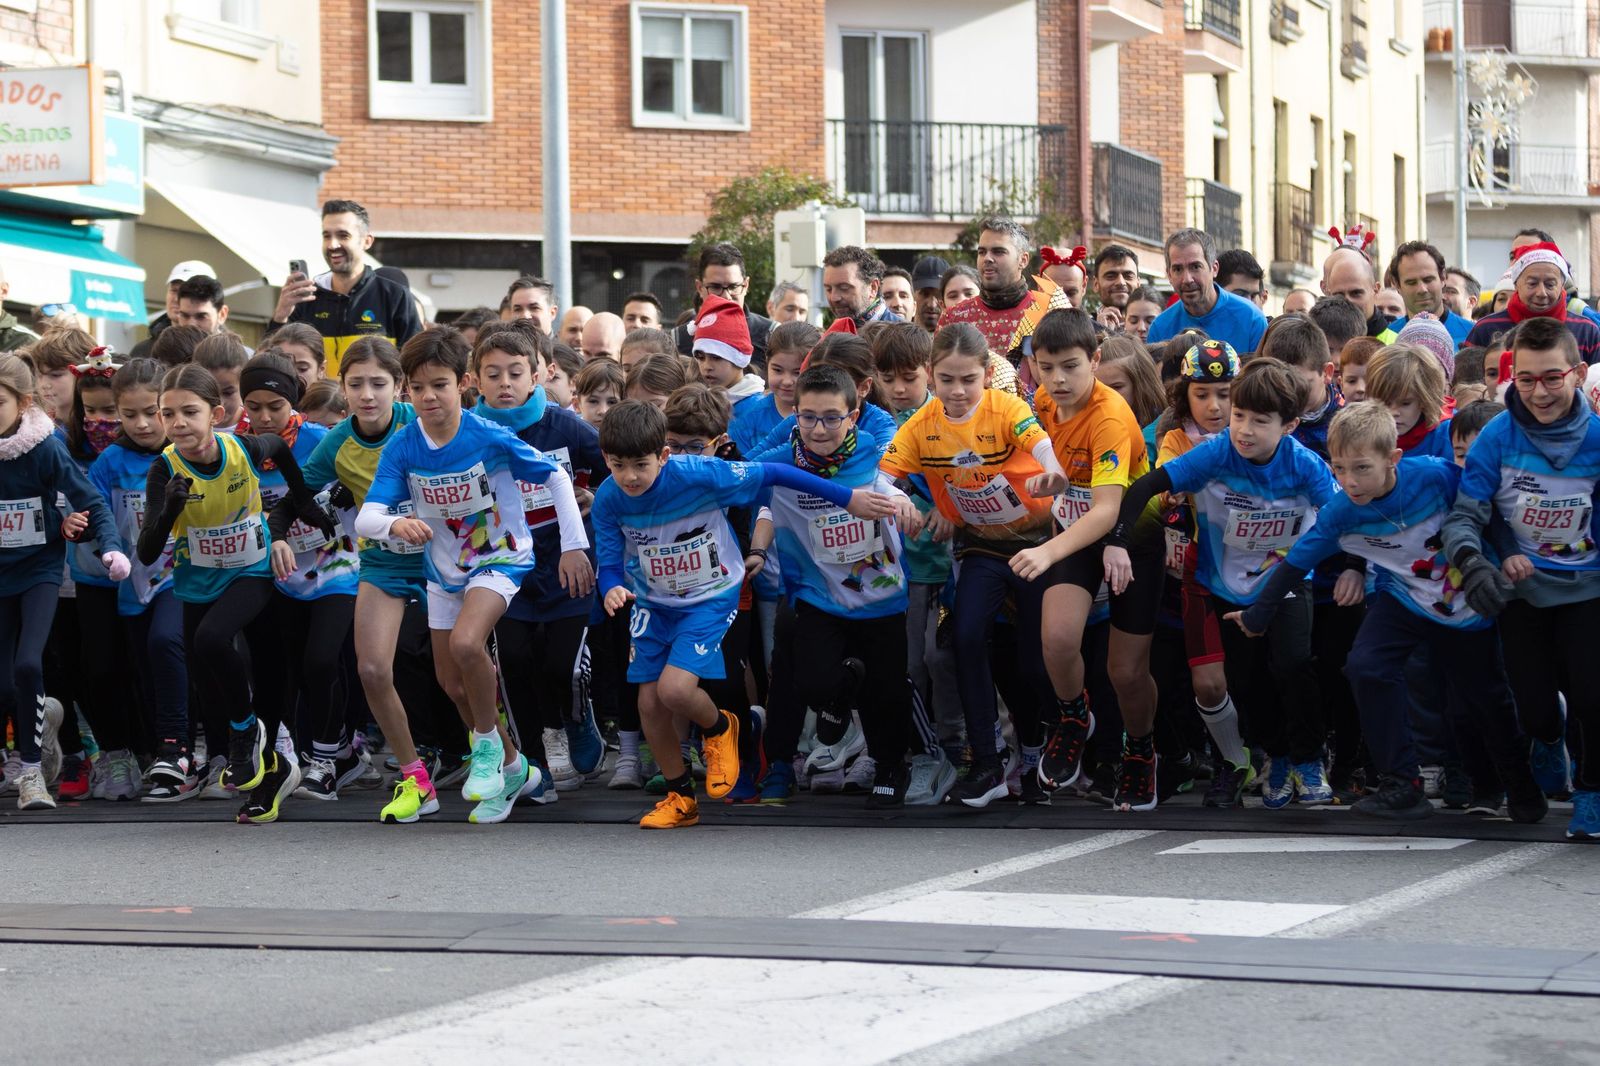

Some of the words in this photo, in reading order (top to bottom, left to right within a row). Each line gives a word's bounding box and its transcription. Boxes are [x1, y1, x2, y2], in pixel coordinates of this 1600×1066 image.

[429, 470, 478, 487] SETEL
[422, 482, 473, 505] 6682
[959, 485, 1001, 498] SETEL
[1065, 488, 1091, 499] ETE
[0, 501, 34, 511] ETEL
[956, 496, 1003, 513] 6990
[1538, 497, 1587, 508] SETEL
[0, 512, 24, 532] 47
[1250, 510, 1299, 521] SETEL
[1521, 507, 1575, 529] 6923
[208, 520, 256, 537] SETEL
[822, 520, 866, 548] 6801
[1235, 520, 1286, 538] 6720
[199, 532, 248, 556] 6587
[659, 537, 708, 556] SETEL
[650, 550, 702, 577] 6840
[872, 786, 895, 796] PUMA
